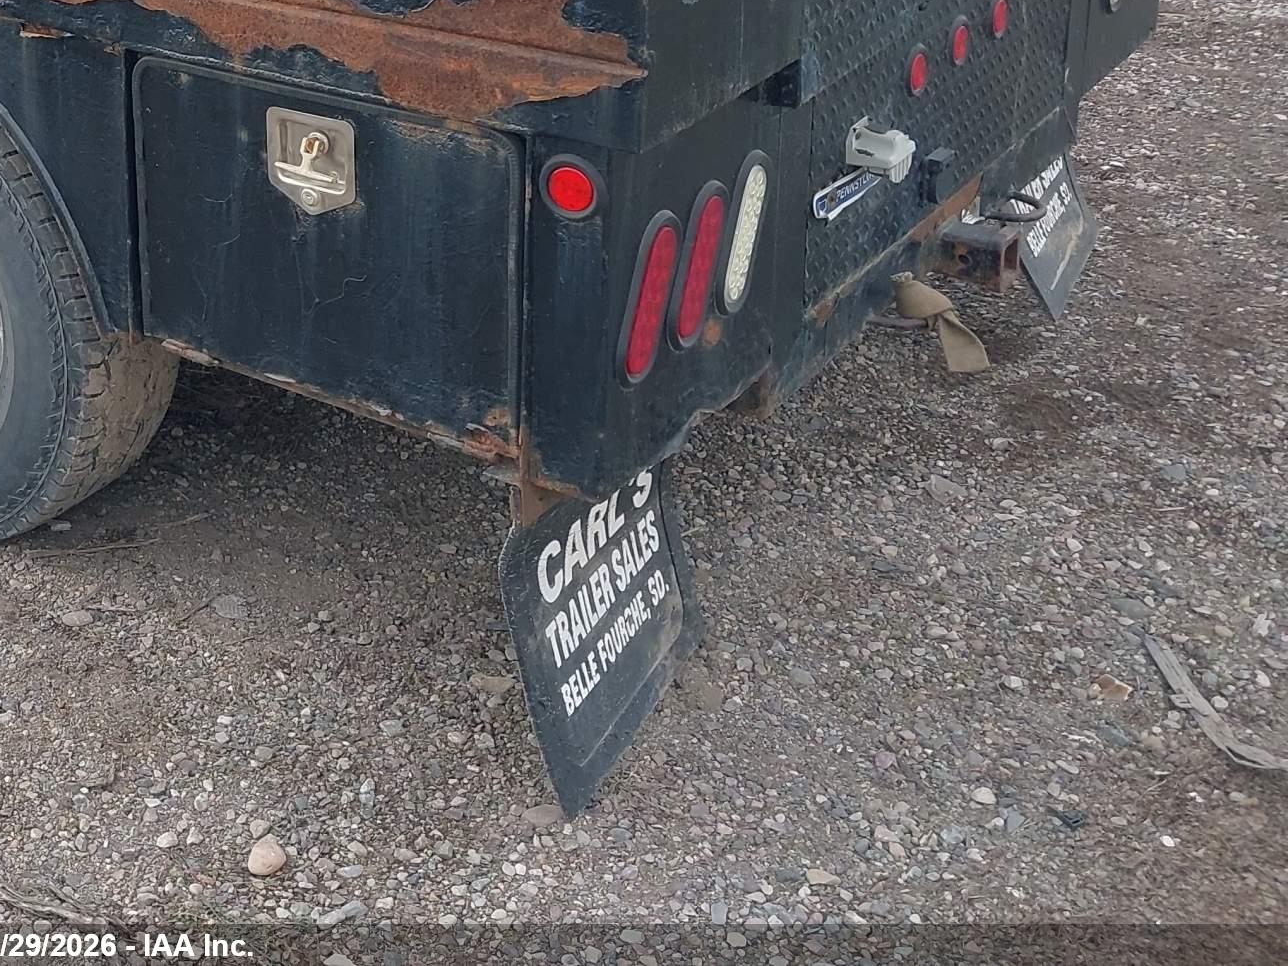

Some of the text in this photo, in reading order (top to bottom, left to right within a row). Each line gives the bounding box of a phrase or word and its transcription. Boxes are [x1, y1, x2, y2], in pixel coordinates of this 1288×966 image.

[545, 509, 660, 669] TRAILER SALES
[560, 569, 670, 717] BELLE FOURCHE, SD.
